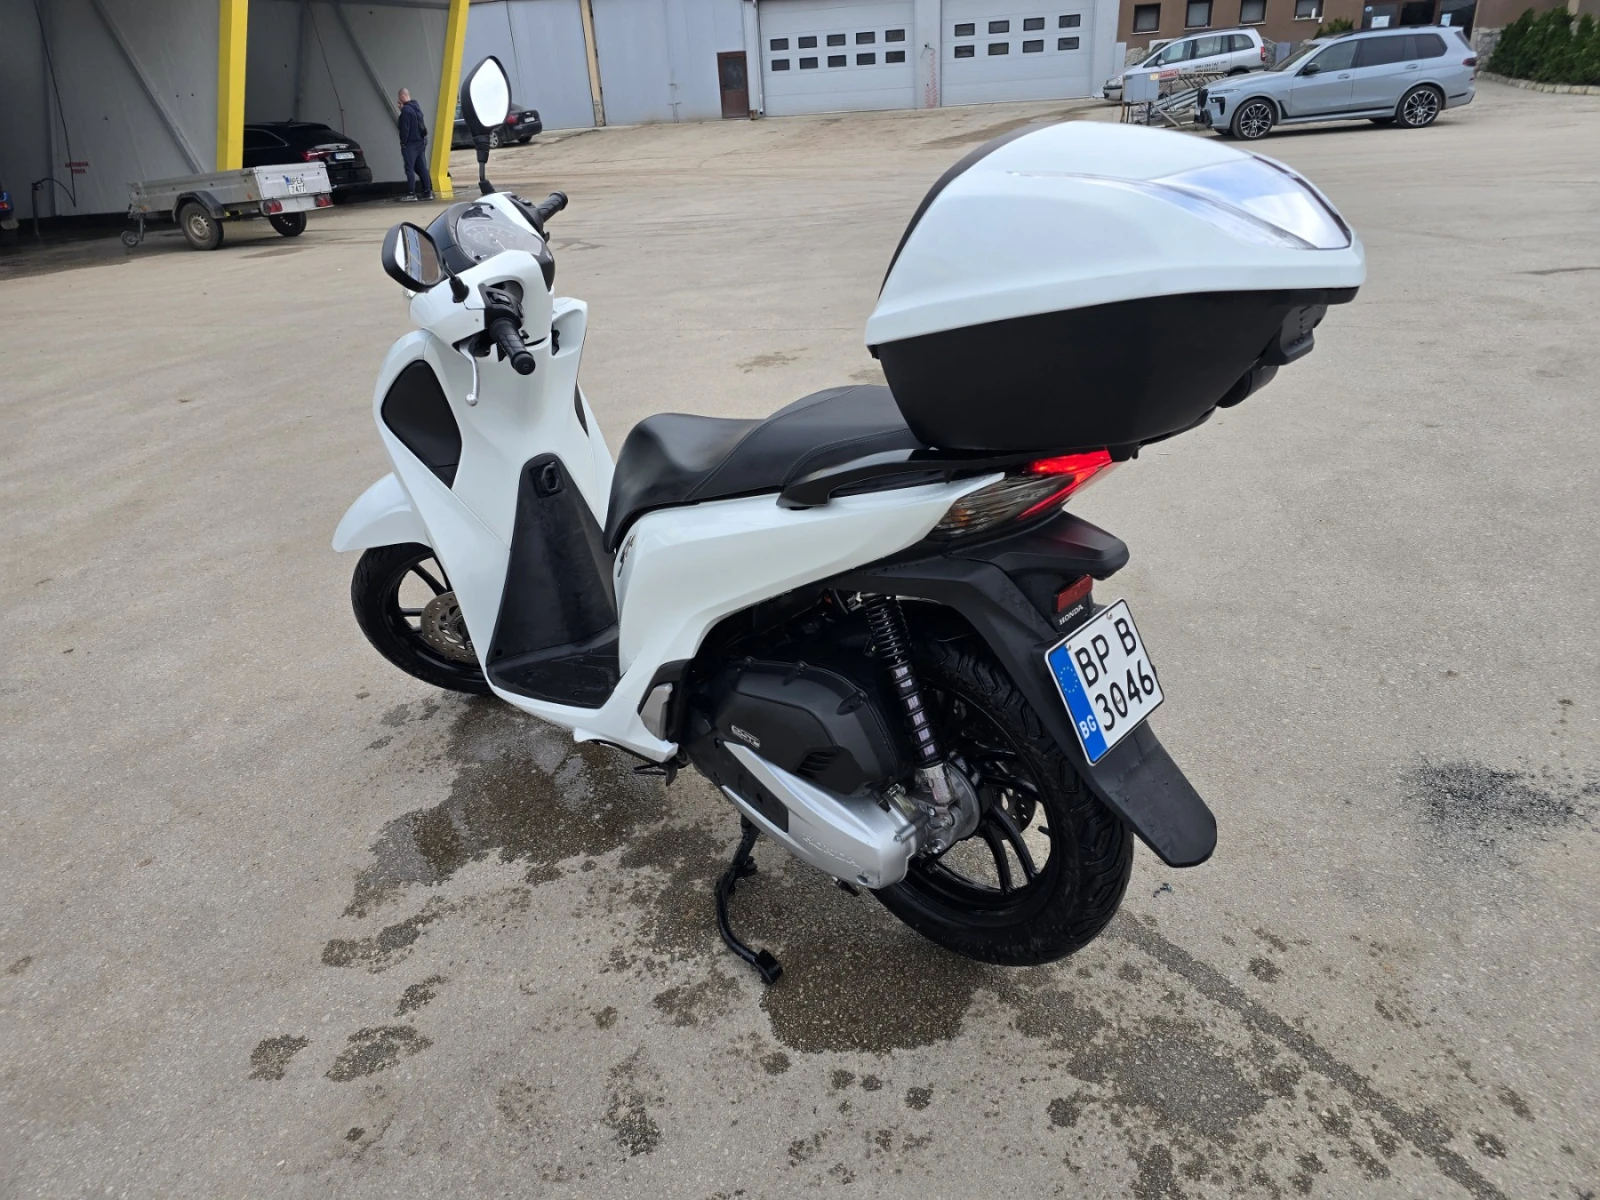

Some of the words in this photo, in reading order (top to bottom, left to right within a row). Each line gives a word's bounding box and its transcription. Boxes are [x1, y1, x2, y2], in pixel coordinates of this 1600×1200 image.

[1058, 604, 1084, 625] HONDA
[1074, 634, 1110, 688] BP
[1113, 617, 1137, 657] B
[1094, 659, 1154, 732] 3046
[1079, 715, 1097, 739] BG
